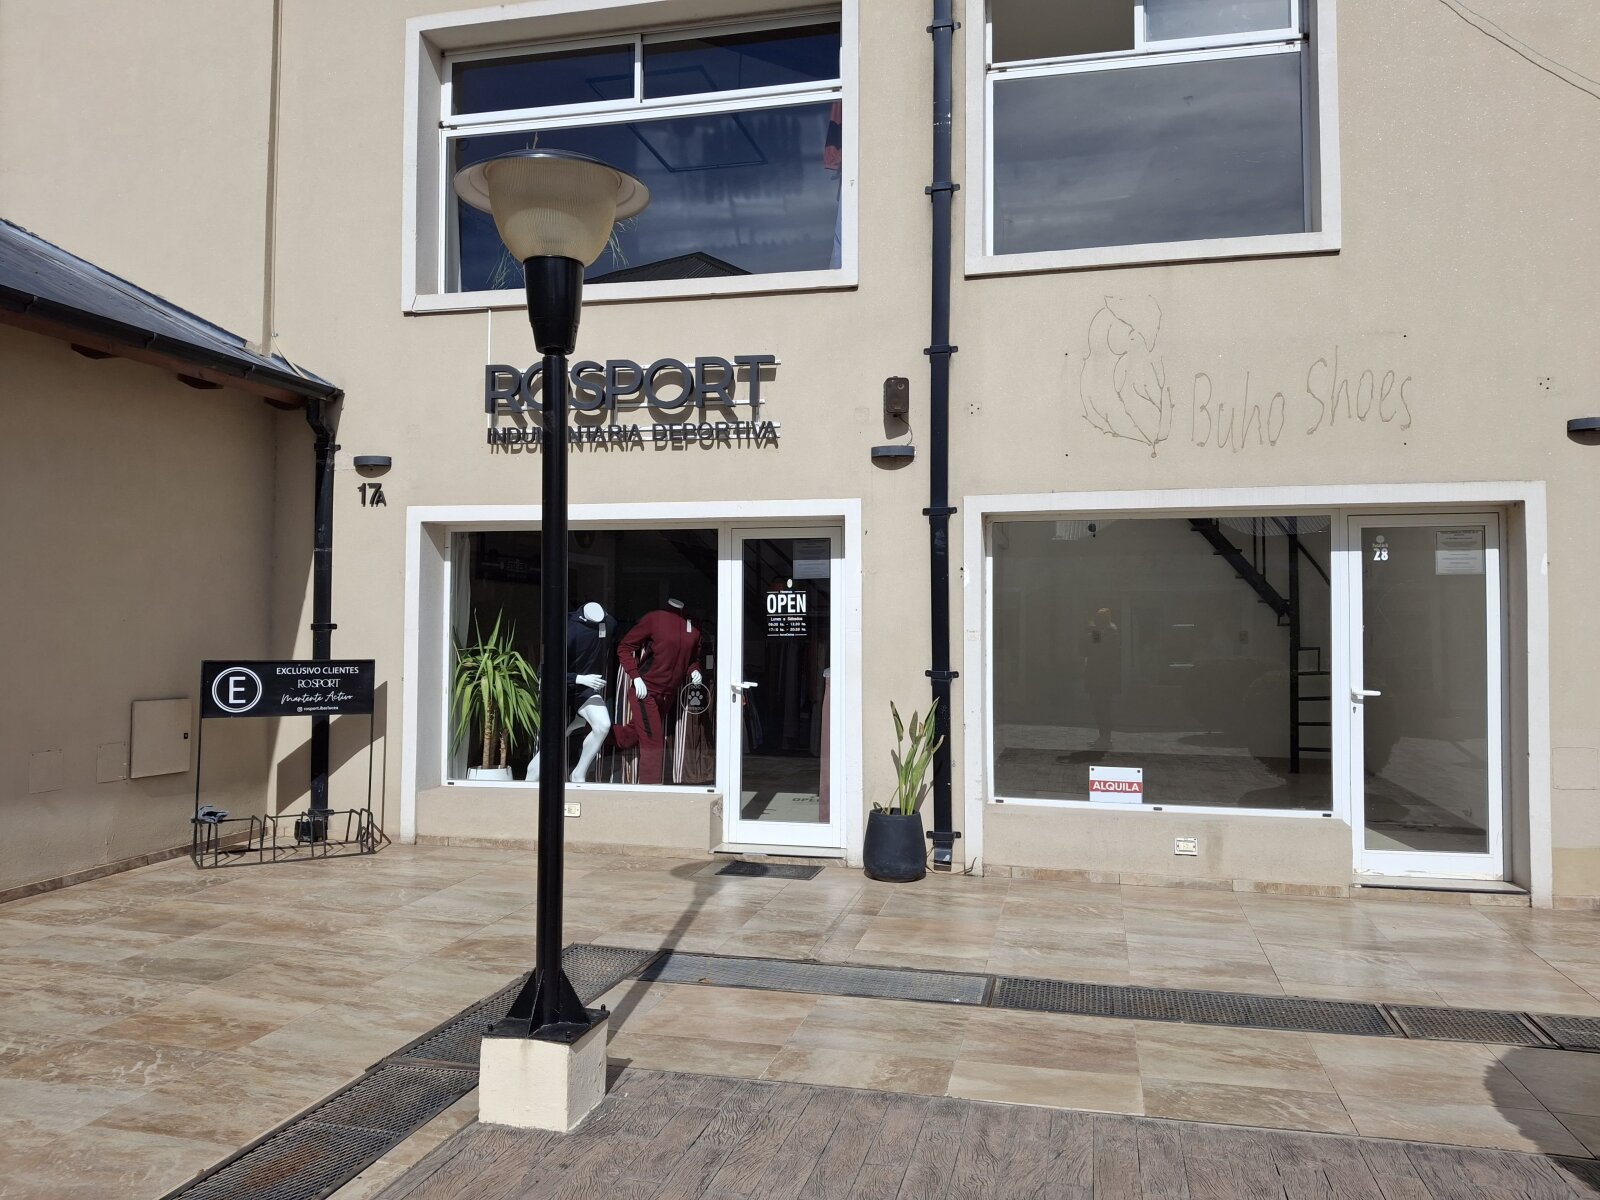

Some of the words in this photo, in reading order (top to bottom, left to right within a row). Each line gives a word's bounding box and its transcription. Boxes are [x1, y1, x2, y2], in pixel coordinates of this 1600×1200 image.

[1306, 345, 1412, 435] Shoes
[652, 420, 778, 442] DEPORTIVA
[357, 482, 387, 507] 17A
[1373, 548, 1389, 561] 28
[766, 593, 807, 613] OPEN
[276, 666, 321, 675] EXCLUSIVO
[322, 666, 359, 675] CLIENTES
[228, 676, 246, 704] E
[297, 678, 341, 688] ROSPORT
[324, 690, 353, 702] Activo
[1092, 781, 1140, 791] ALQUILA
